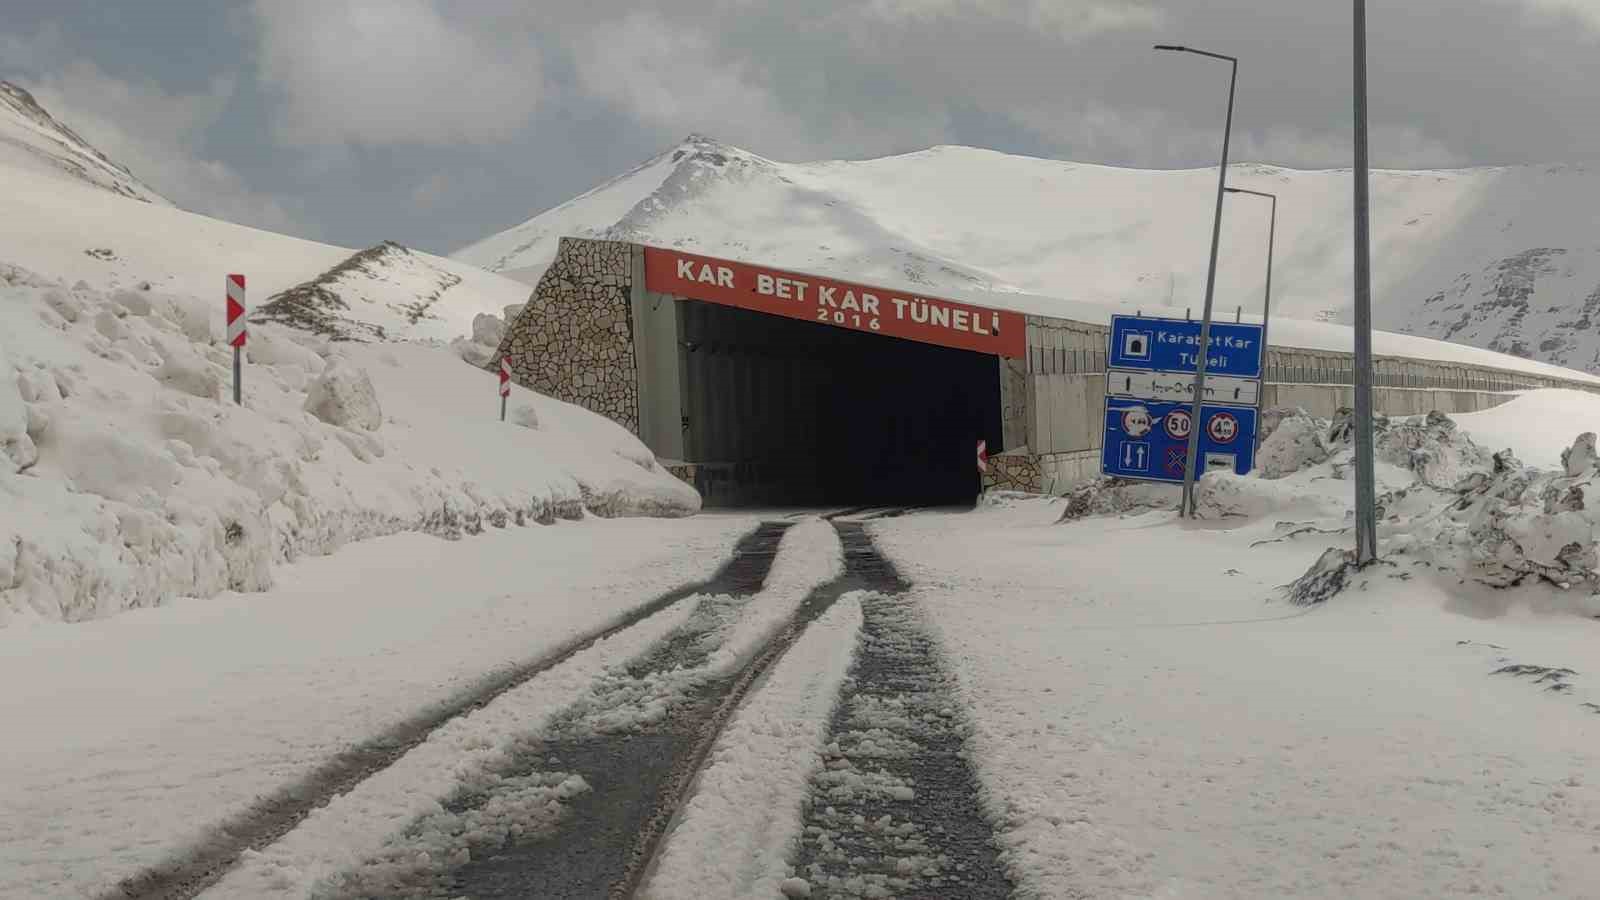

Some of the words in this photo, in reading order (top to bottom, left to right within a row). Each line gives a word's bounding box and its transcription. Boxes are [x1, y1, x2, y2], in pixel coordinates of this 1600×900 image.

[677, 259, 735, 289] KAR
[757, 274, 809, 302] BET
[818, 285, 881, 316] KAR
[816, 308, 881, 331] 2016
[1224, 336, 1252, 349] Kar
[1170, 418, 1189, 431] 50
